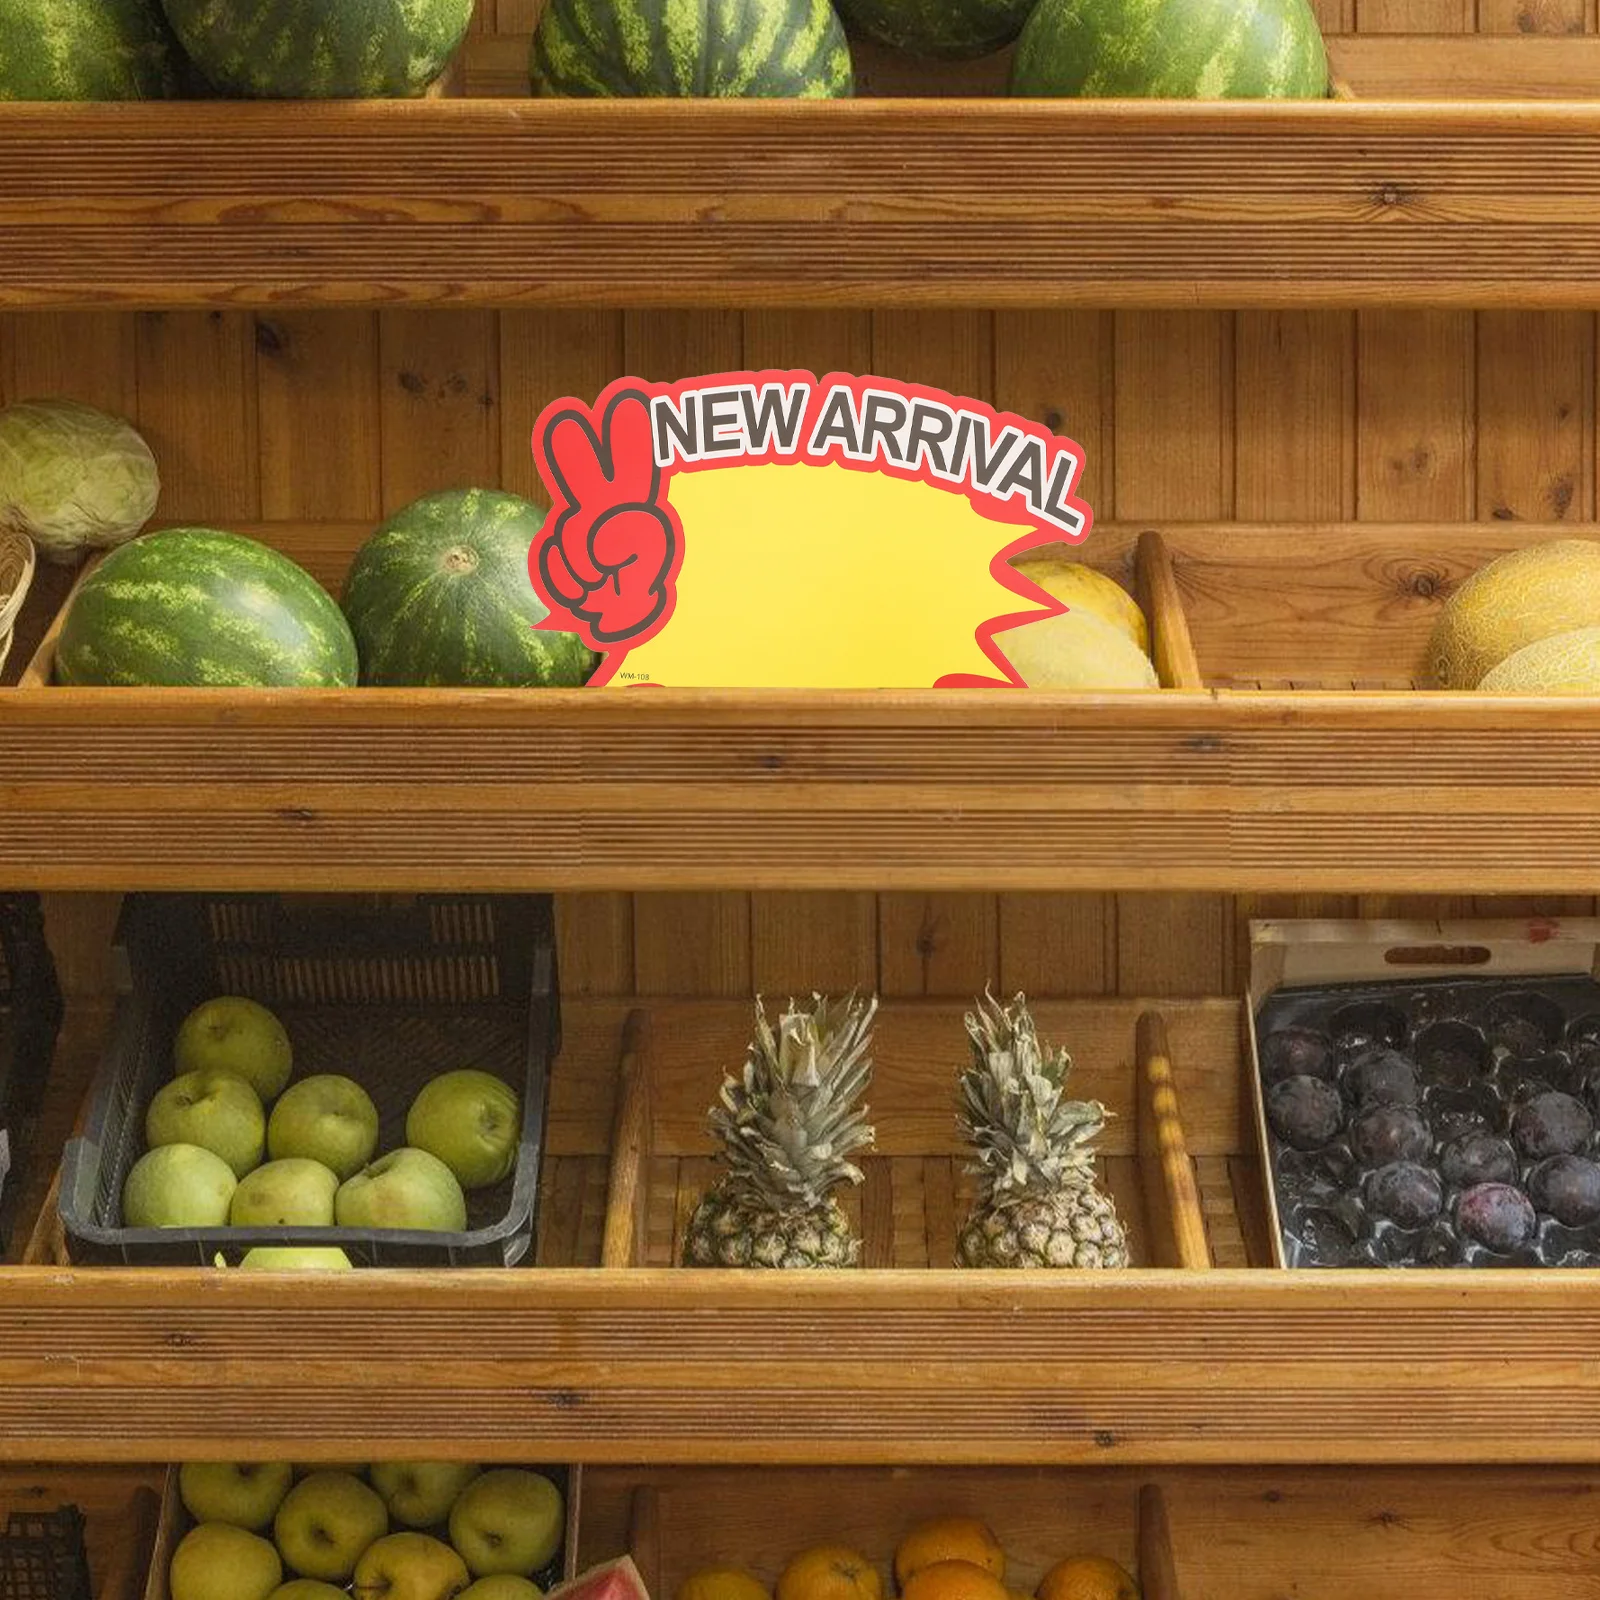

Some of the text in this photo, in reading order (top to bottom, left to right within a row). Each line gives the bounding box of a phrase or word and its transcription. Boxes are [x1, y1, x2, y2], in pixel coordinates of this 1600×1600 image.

[653, 387, 1081, 531] NEW ARRIVAL
[620, 672, 650, 681] WM-108
